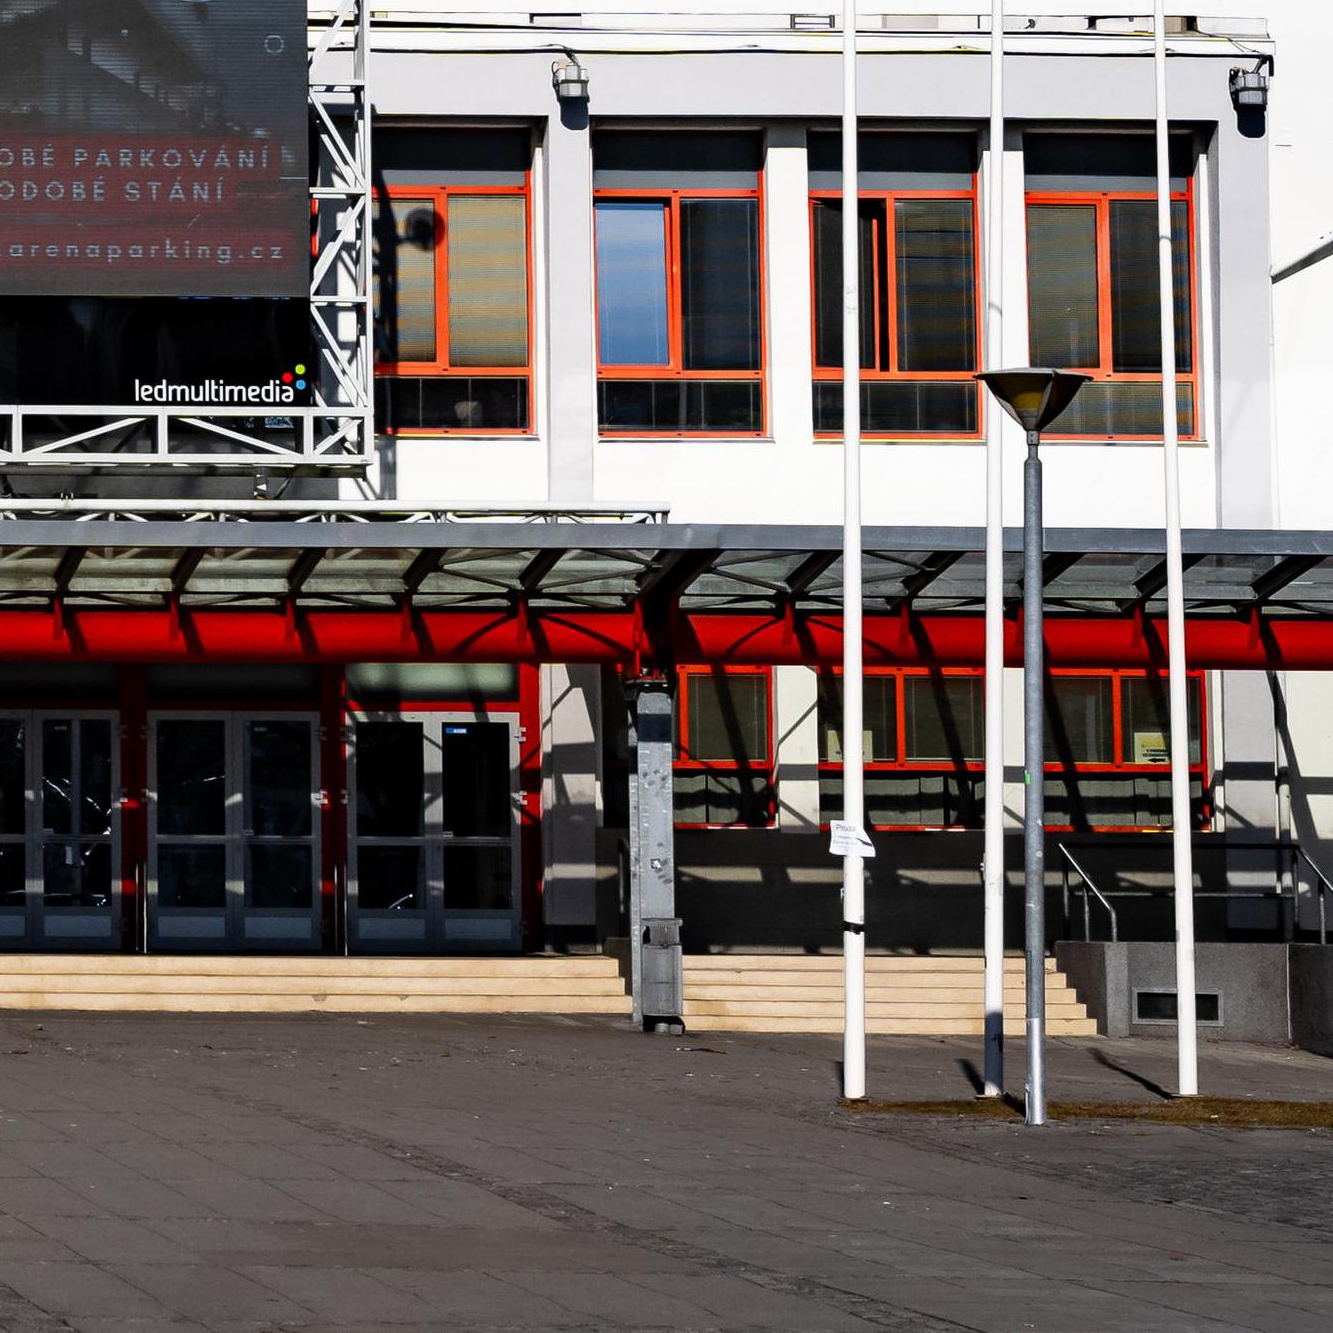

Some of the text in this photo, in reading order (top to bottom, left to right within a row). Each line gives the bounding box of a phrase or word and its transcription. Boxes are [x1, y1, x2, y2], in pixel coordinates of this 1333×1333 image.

[74, 143, 272, 168] PARKOVÁNÍ
[125, 176, 226, 202] STÁNÍ
[134, 379, 294, 402] ledmultimedia
